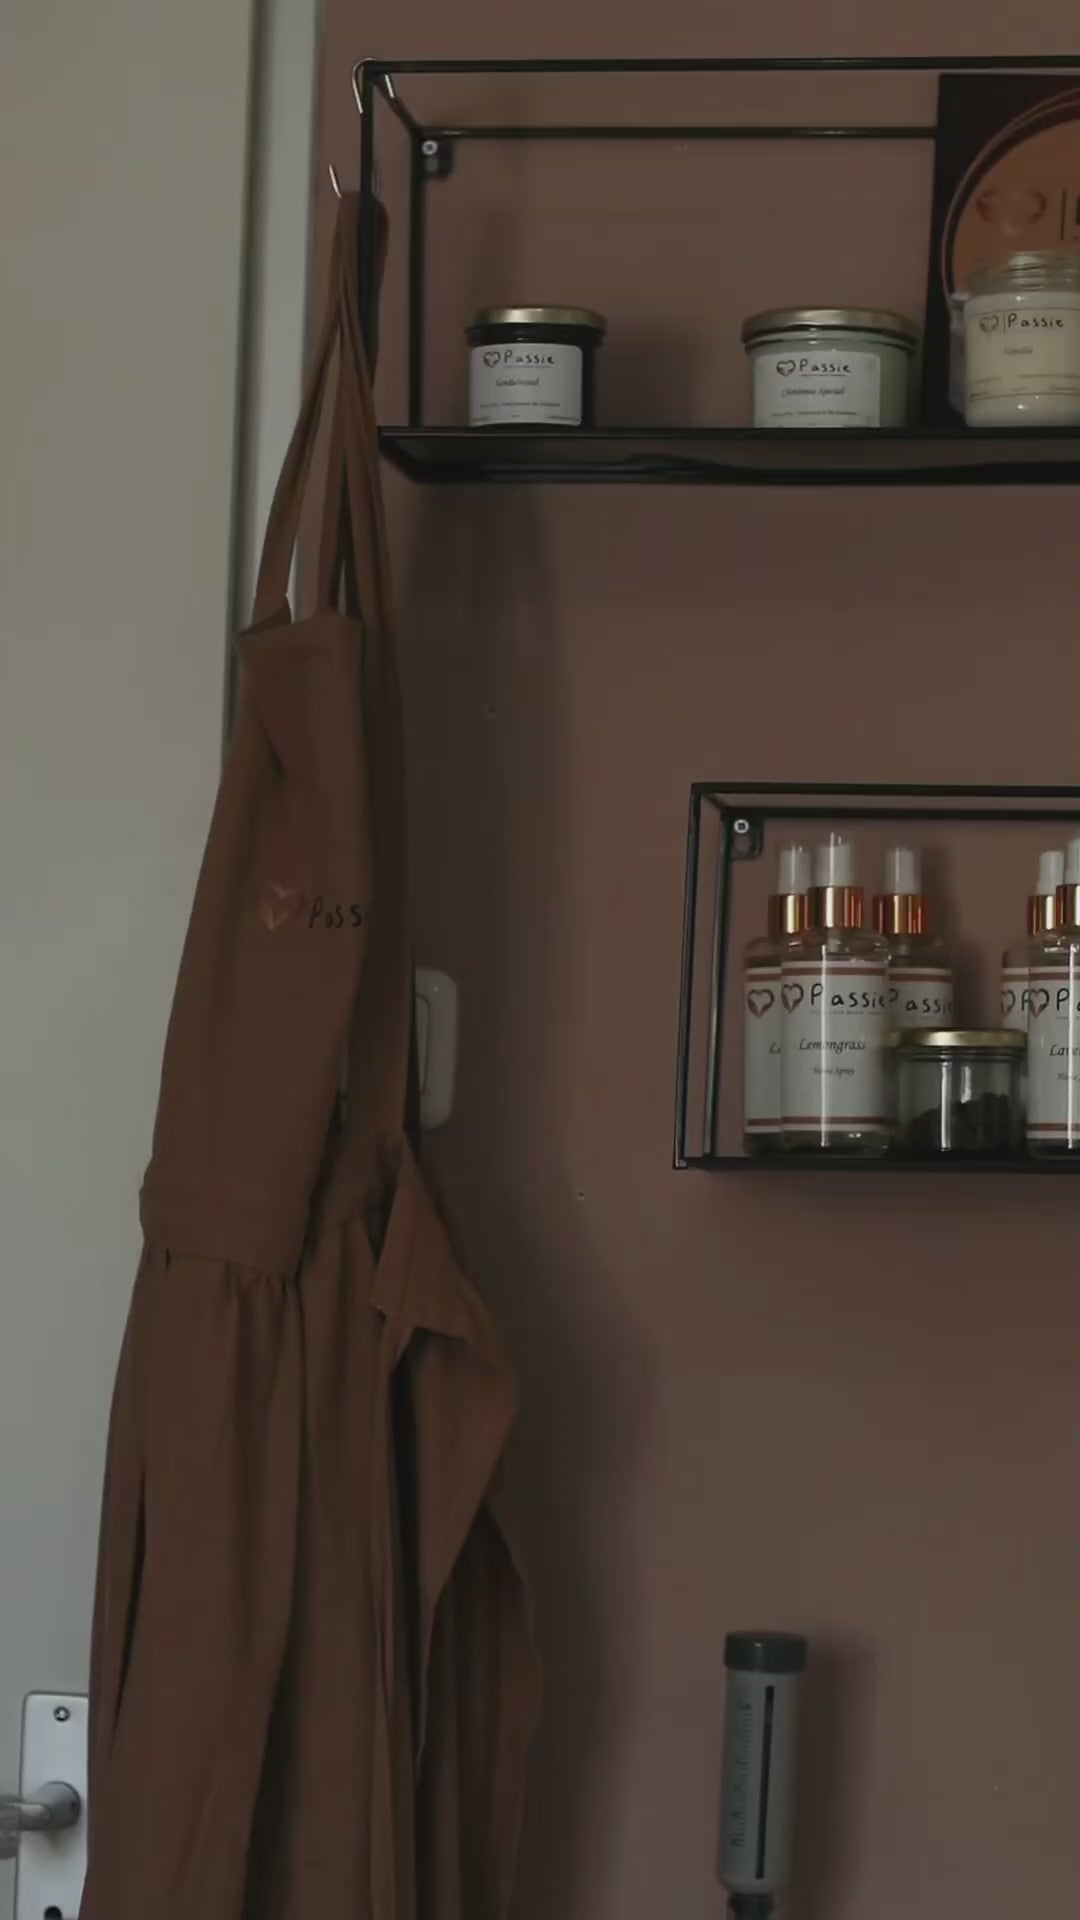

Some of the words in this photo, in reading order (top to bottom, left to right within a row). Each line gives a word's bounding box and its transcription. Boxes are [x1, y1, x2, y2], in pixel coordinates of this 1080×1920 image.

[1007, 312, 1065, 328] Passie
[503, 349, 556, 365] Passie
[799, 358, 851, 373] Passie
[810, 983, 886, 1008] Passie
